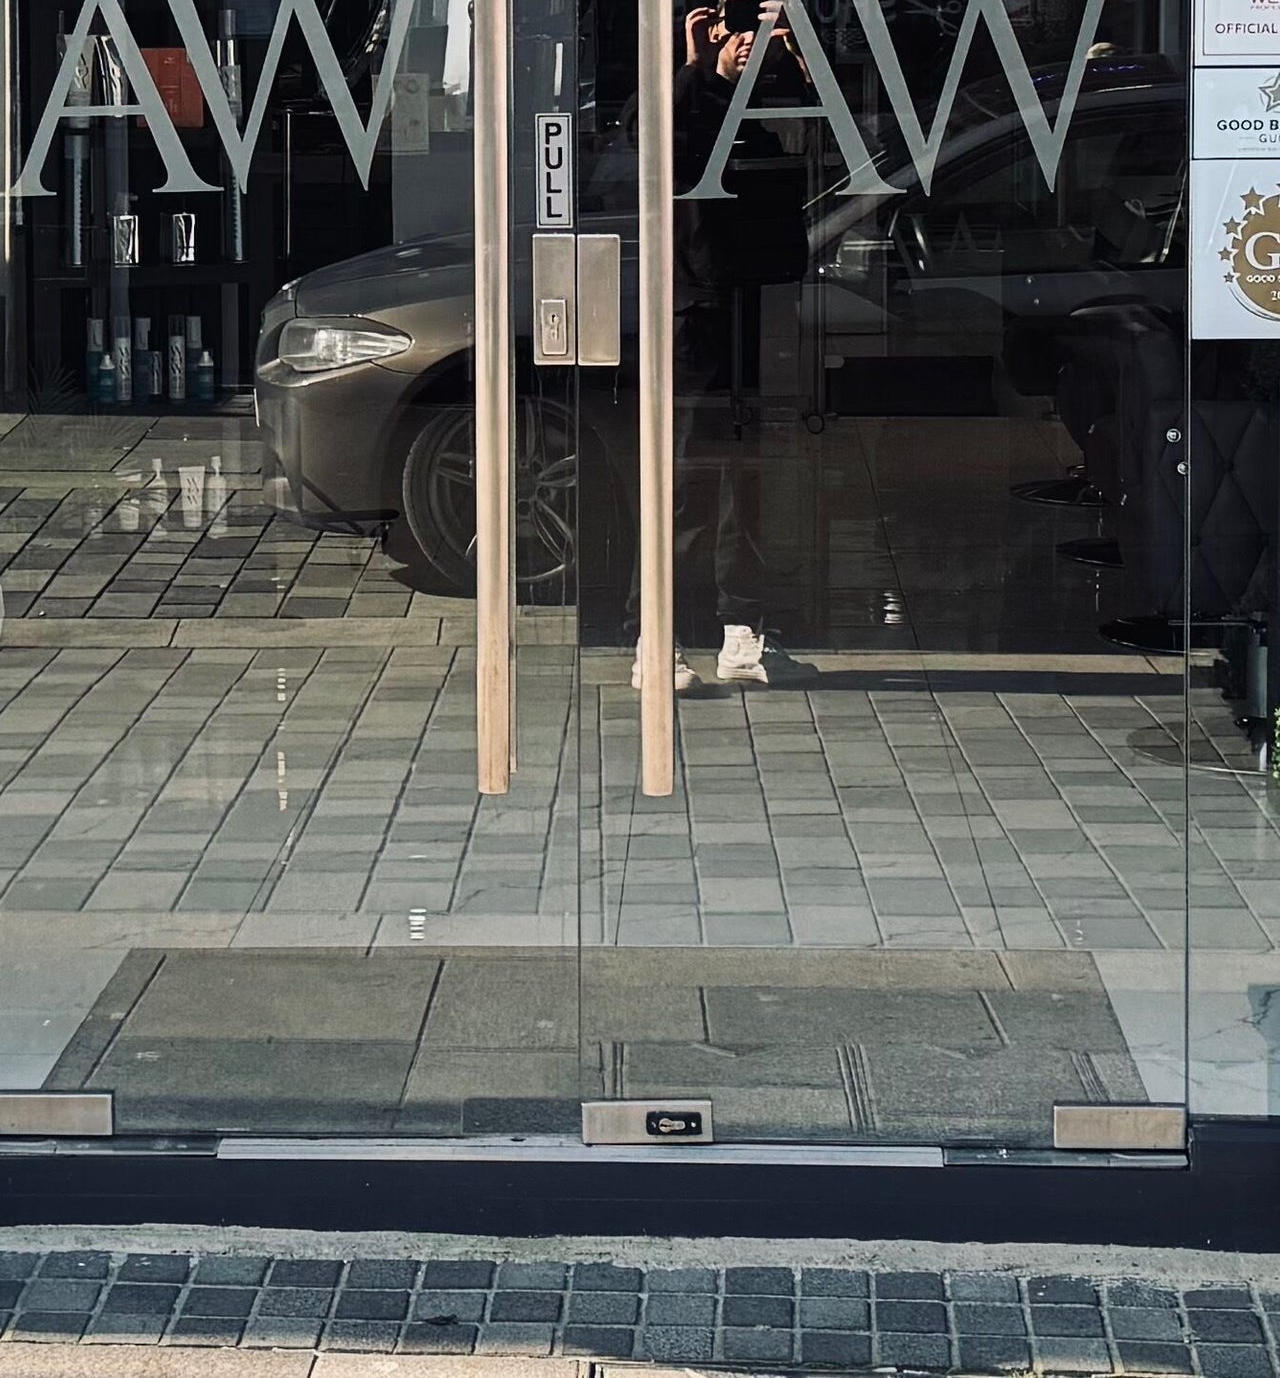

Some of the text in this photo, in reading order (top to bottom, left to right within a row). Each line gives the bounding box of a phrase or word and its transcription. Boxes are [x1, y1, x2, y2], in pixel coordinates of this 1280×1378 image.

[1215, 22, 1278, 35] OFFICIAL
[1217, 119, 1264, 132] GOOD
[544, 122, 563, 218] PULL
[1246, 274, 1276, 284] GOOD
